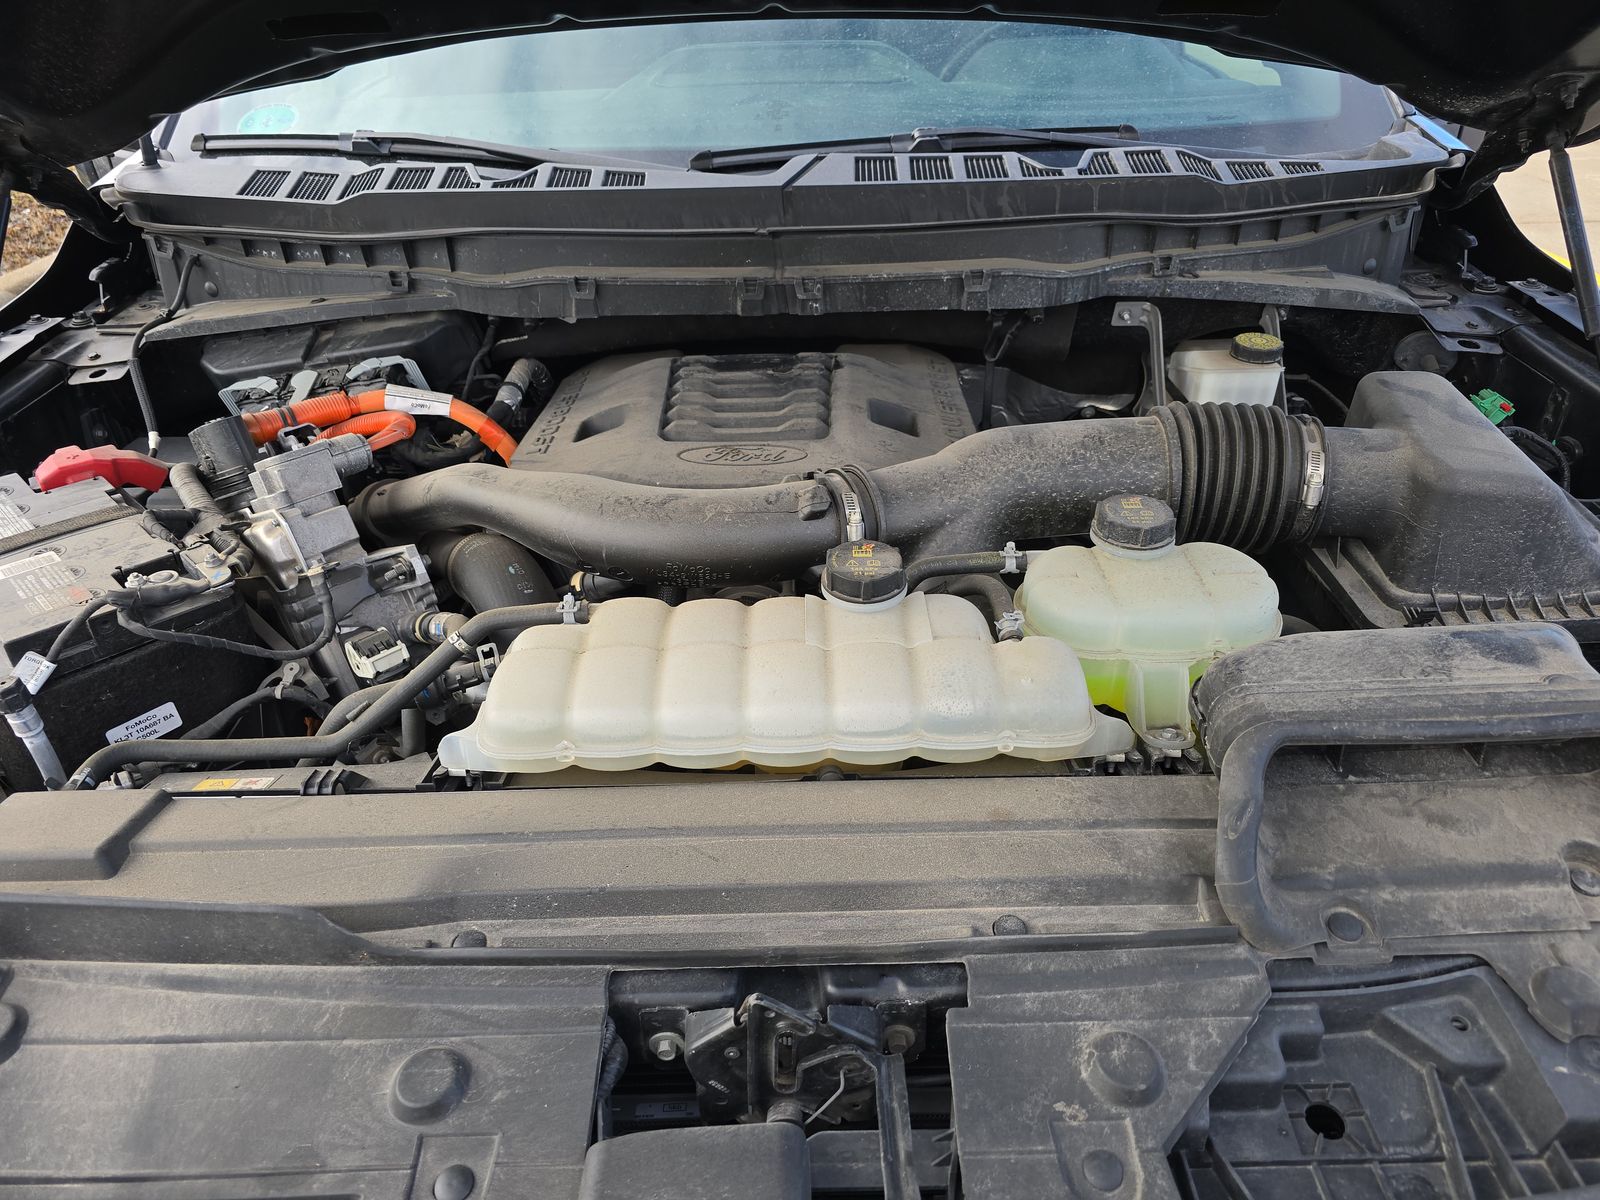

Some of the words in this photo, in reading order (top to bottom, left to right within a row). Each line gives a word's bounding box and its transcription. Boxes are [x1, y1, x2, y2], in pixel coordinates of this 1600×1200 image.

[702, 446, 788, 462] Ford
[125, 714, 157, 731] FoMoCo
[163, 713, 175, 721] BA
